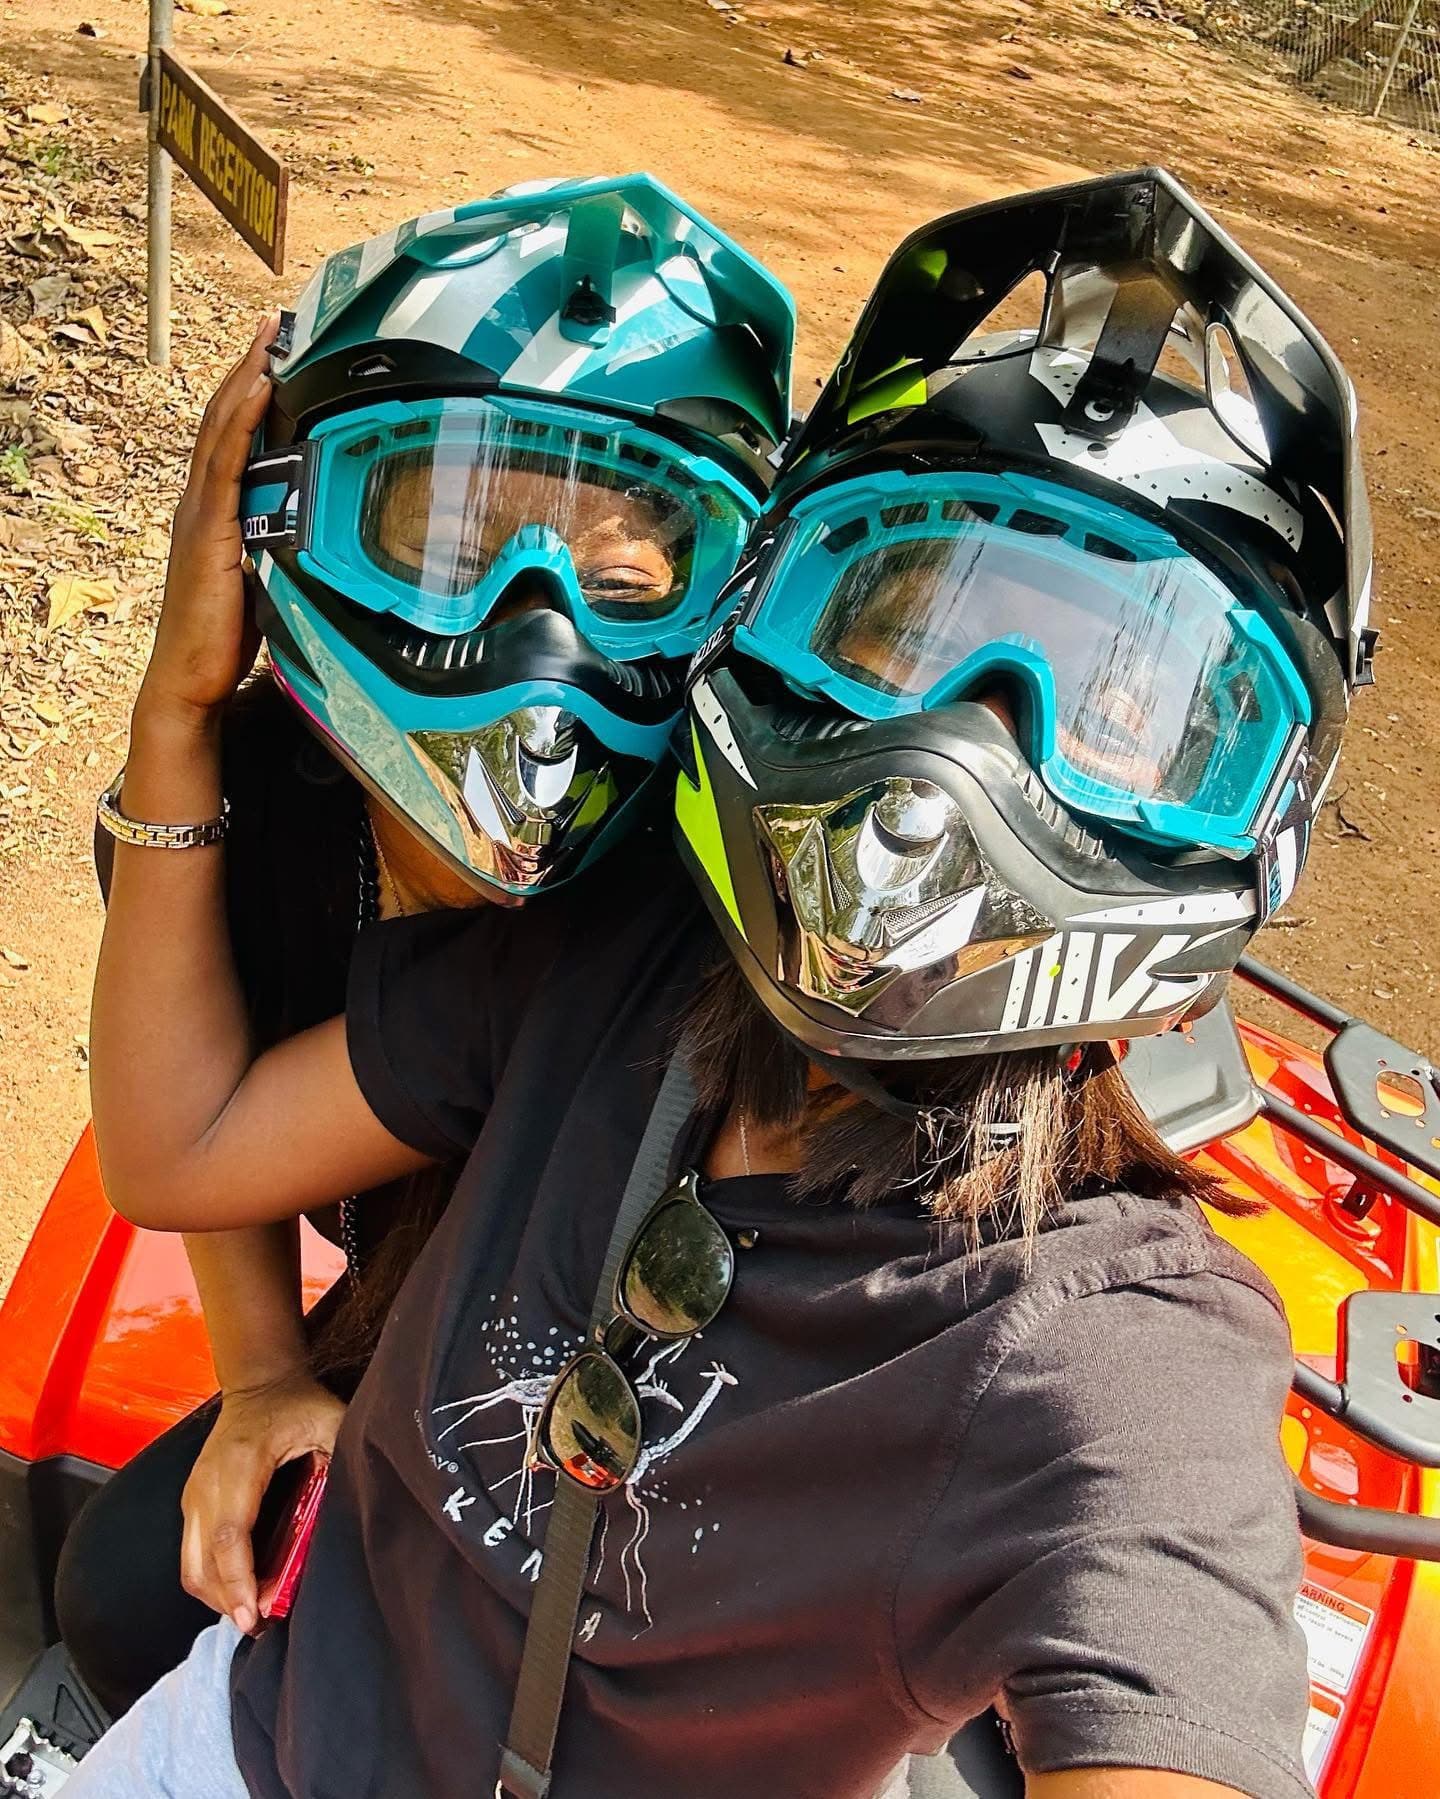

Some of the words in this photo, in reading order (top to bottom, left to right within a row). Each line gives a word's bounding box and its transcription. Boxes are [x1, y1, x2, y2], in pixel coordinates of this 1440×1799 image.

[161, 71, 197, 161] PARK
[200, 112, 278, 248] RECEPTION
[442, 1486, 602, 1643] KENA
[1300, 1583, 1345, 1612] ARNING
